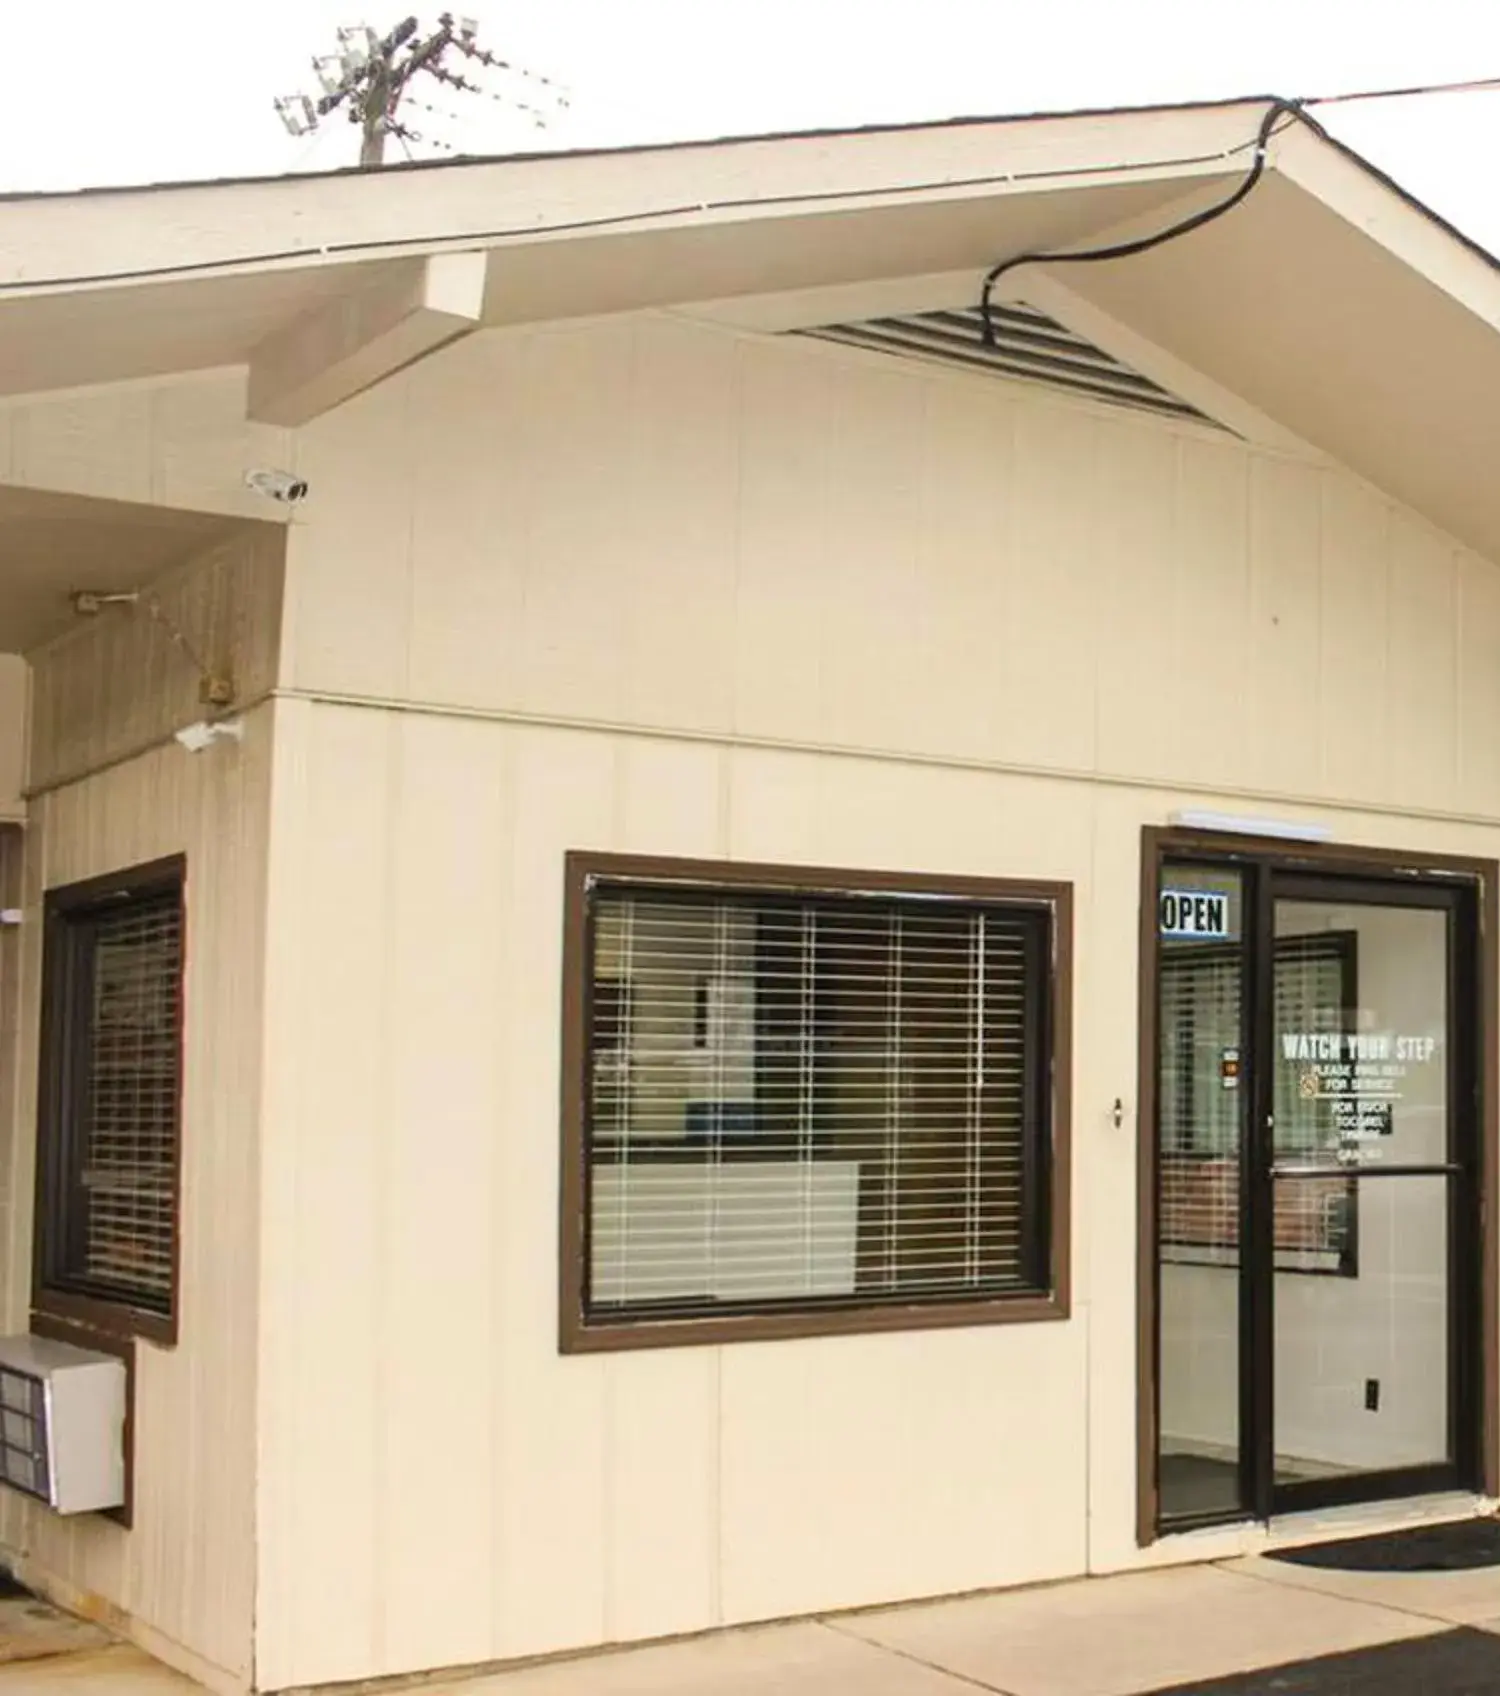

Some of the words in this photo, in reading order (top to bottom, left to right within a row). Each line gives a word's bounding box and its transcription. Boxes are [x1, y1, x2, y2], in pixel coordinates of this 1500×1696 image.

[1162, 895, 1223, 932] OPEN
[1283, 1034, 1341, 1060] WATCH
[1347, 1035, 1389, 1060] YOUR
[1396, 1036, 1434, 1061] STEP
